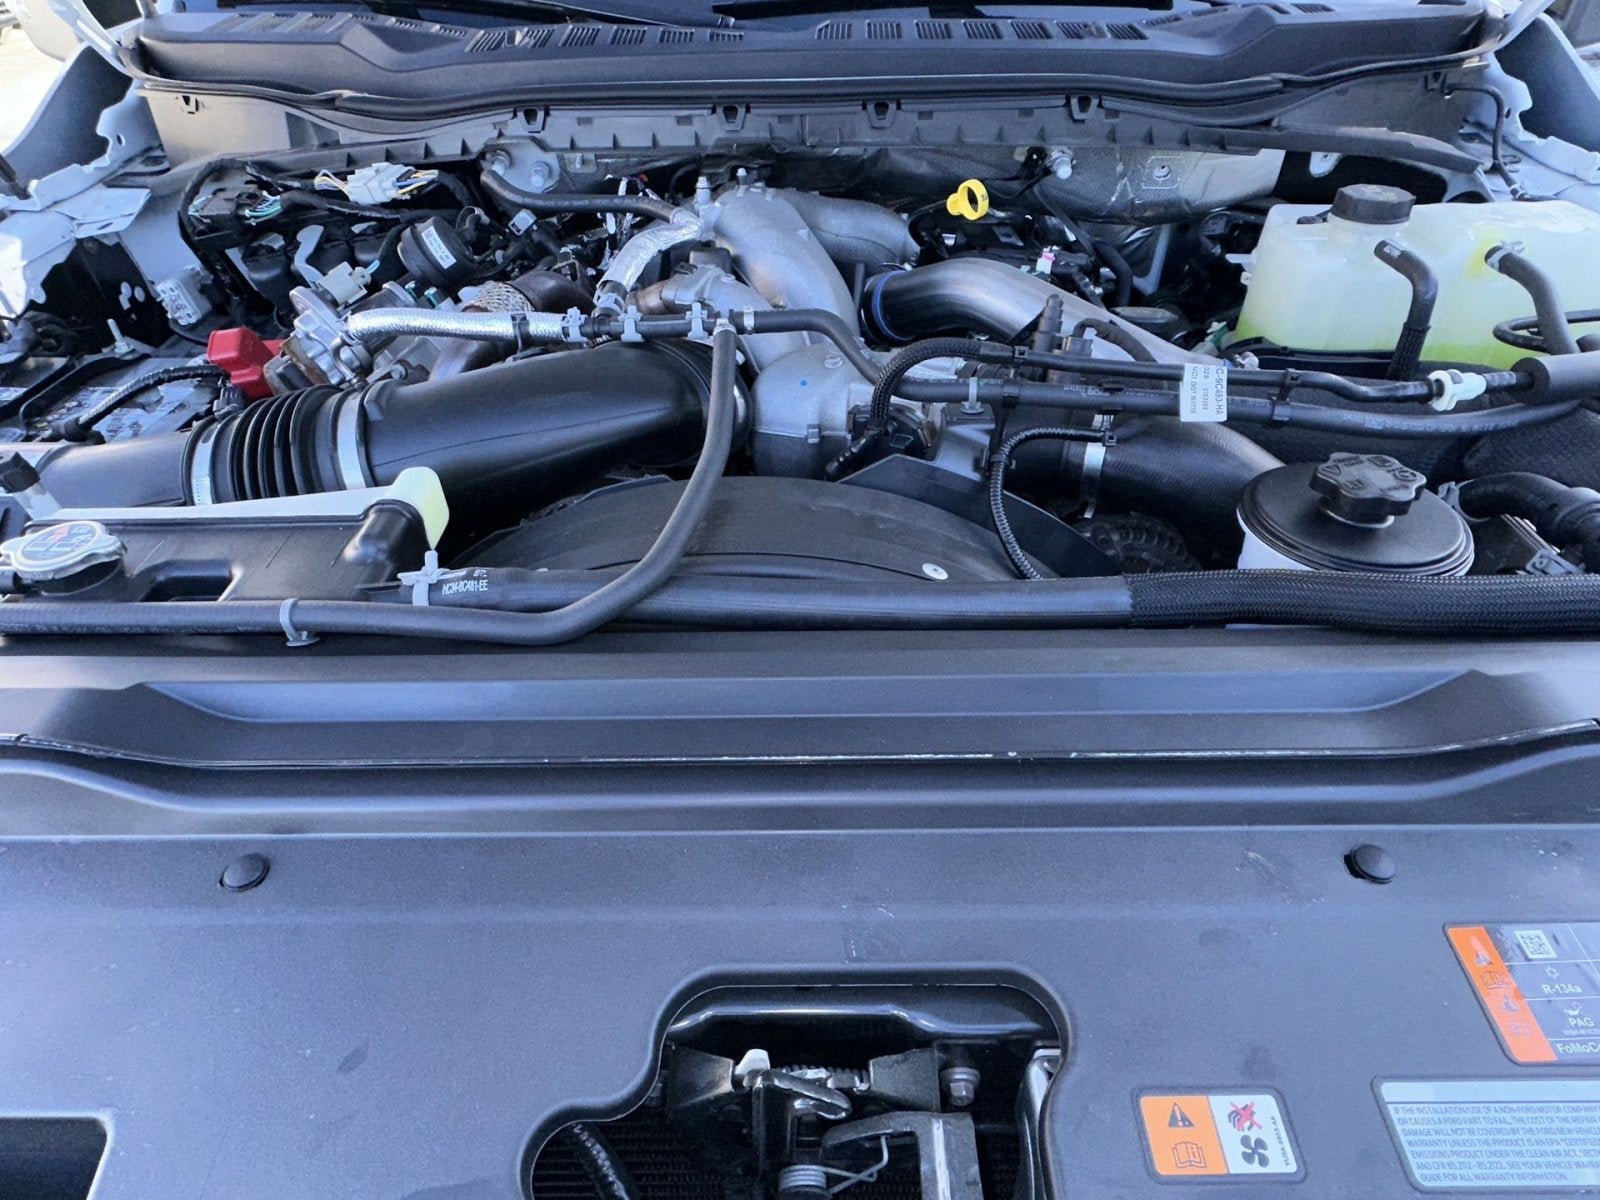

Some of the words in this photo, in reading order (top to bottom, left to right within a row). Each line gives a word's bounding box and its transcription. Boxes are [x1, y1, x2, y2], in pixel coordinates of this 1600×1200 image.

[1541, 983, 1583, 995] R-134a
[1568, 1016, 1595, 1028] PAG
[1400, 1106, 1416, 1114] THE
[1535, 1105, 1563, 1113] MOTOR
[1462, 1116, 1482, 1124] PART
[1482, 1116, 1495, 1124] TO
[1510, 1116, 1527, 1124] THE
[1525, 1116, 1546, 1124] COST
[1402, 1128, 1434, 1136] DAMAGE
[1465, 1127, 1477, 1135] BE
[1475, 1127, 1511, 1135] COVERED
[1509, 1127, 1521, 1135] BY
[1520, 1127, 1537, 1135] THE
[1534, 1127, 1557, 1135] FORD
[1407, 1139, 1449, 1147] WARRANTY
[1490, 1138, 1526, 1146] PRODUCT
[1524, 1138, 1535, 1146] IS
[1544, 1138, 1562, 1146] EPA
[1524, 1149, 1550, 1157] CLEAN
[1549, 1149, 1563, 1157] AIR
[1505, 1161, 1524, 1169] SEE
[1523, 1161, 1543, 1169] YOUR
[1542, 1161, 1574, 1169] VEHICLE
[1421, 1173, 1443, 1181] GUIDE
[1441, 1172, 1458, 1181] FOR
[1457, 1172, 1473, 1181] ALL
[1472, 1172, 1516, 1181] WARRANTY
